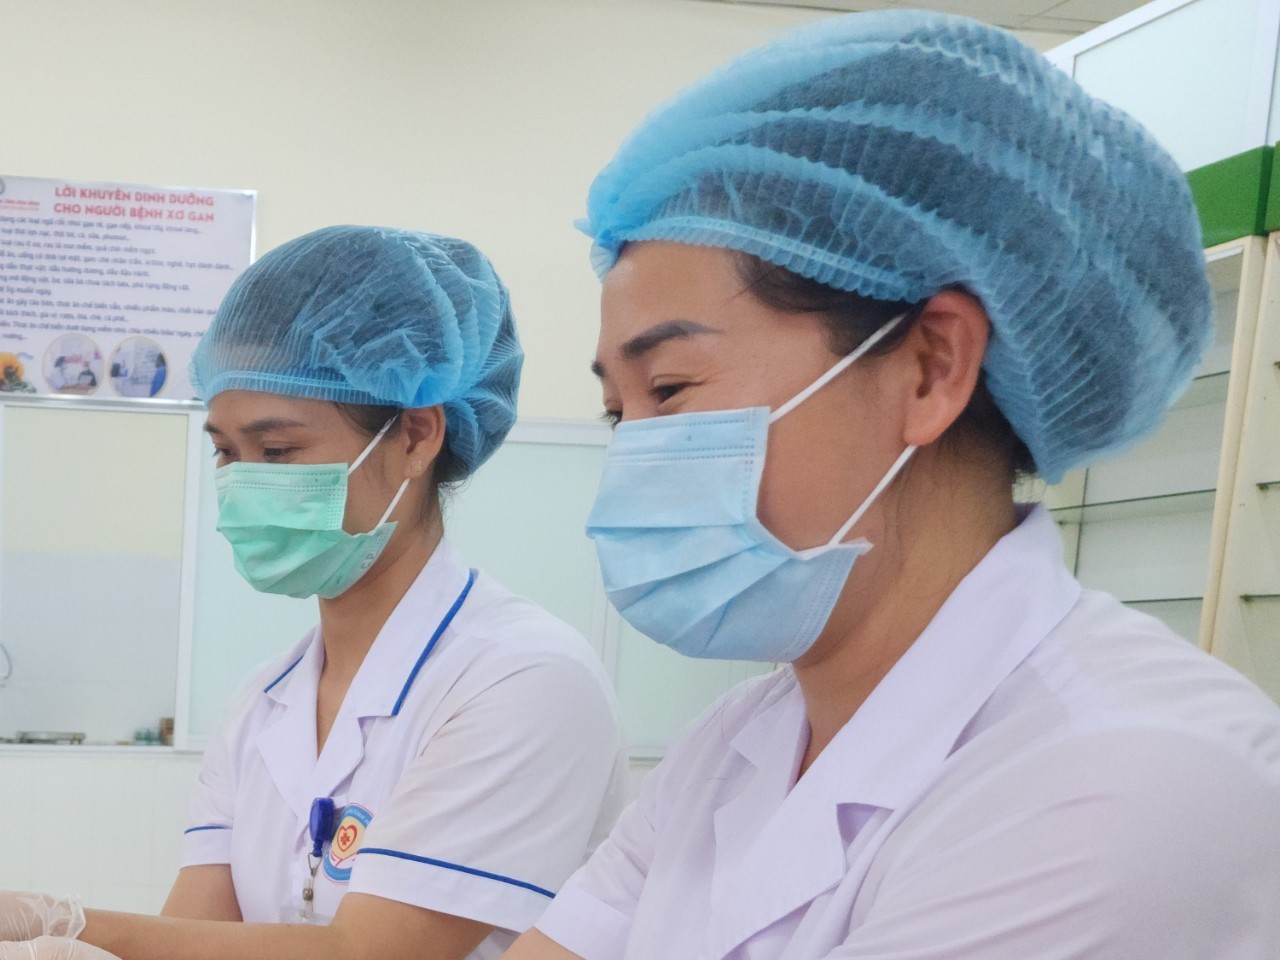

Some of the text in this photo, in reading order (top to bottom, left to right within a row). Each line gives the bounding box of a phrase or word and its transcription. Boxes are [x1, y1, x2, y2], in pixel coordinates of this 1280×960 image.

[79, 187, 131, 201] KHUYÊN
[53, 203, 81, 214] CHO
[188, 211, 214, 222] GAN
